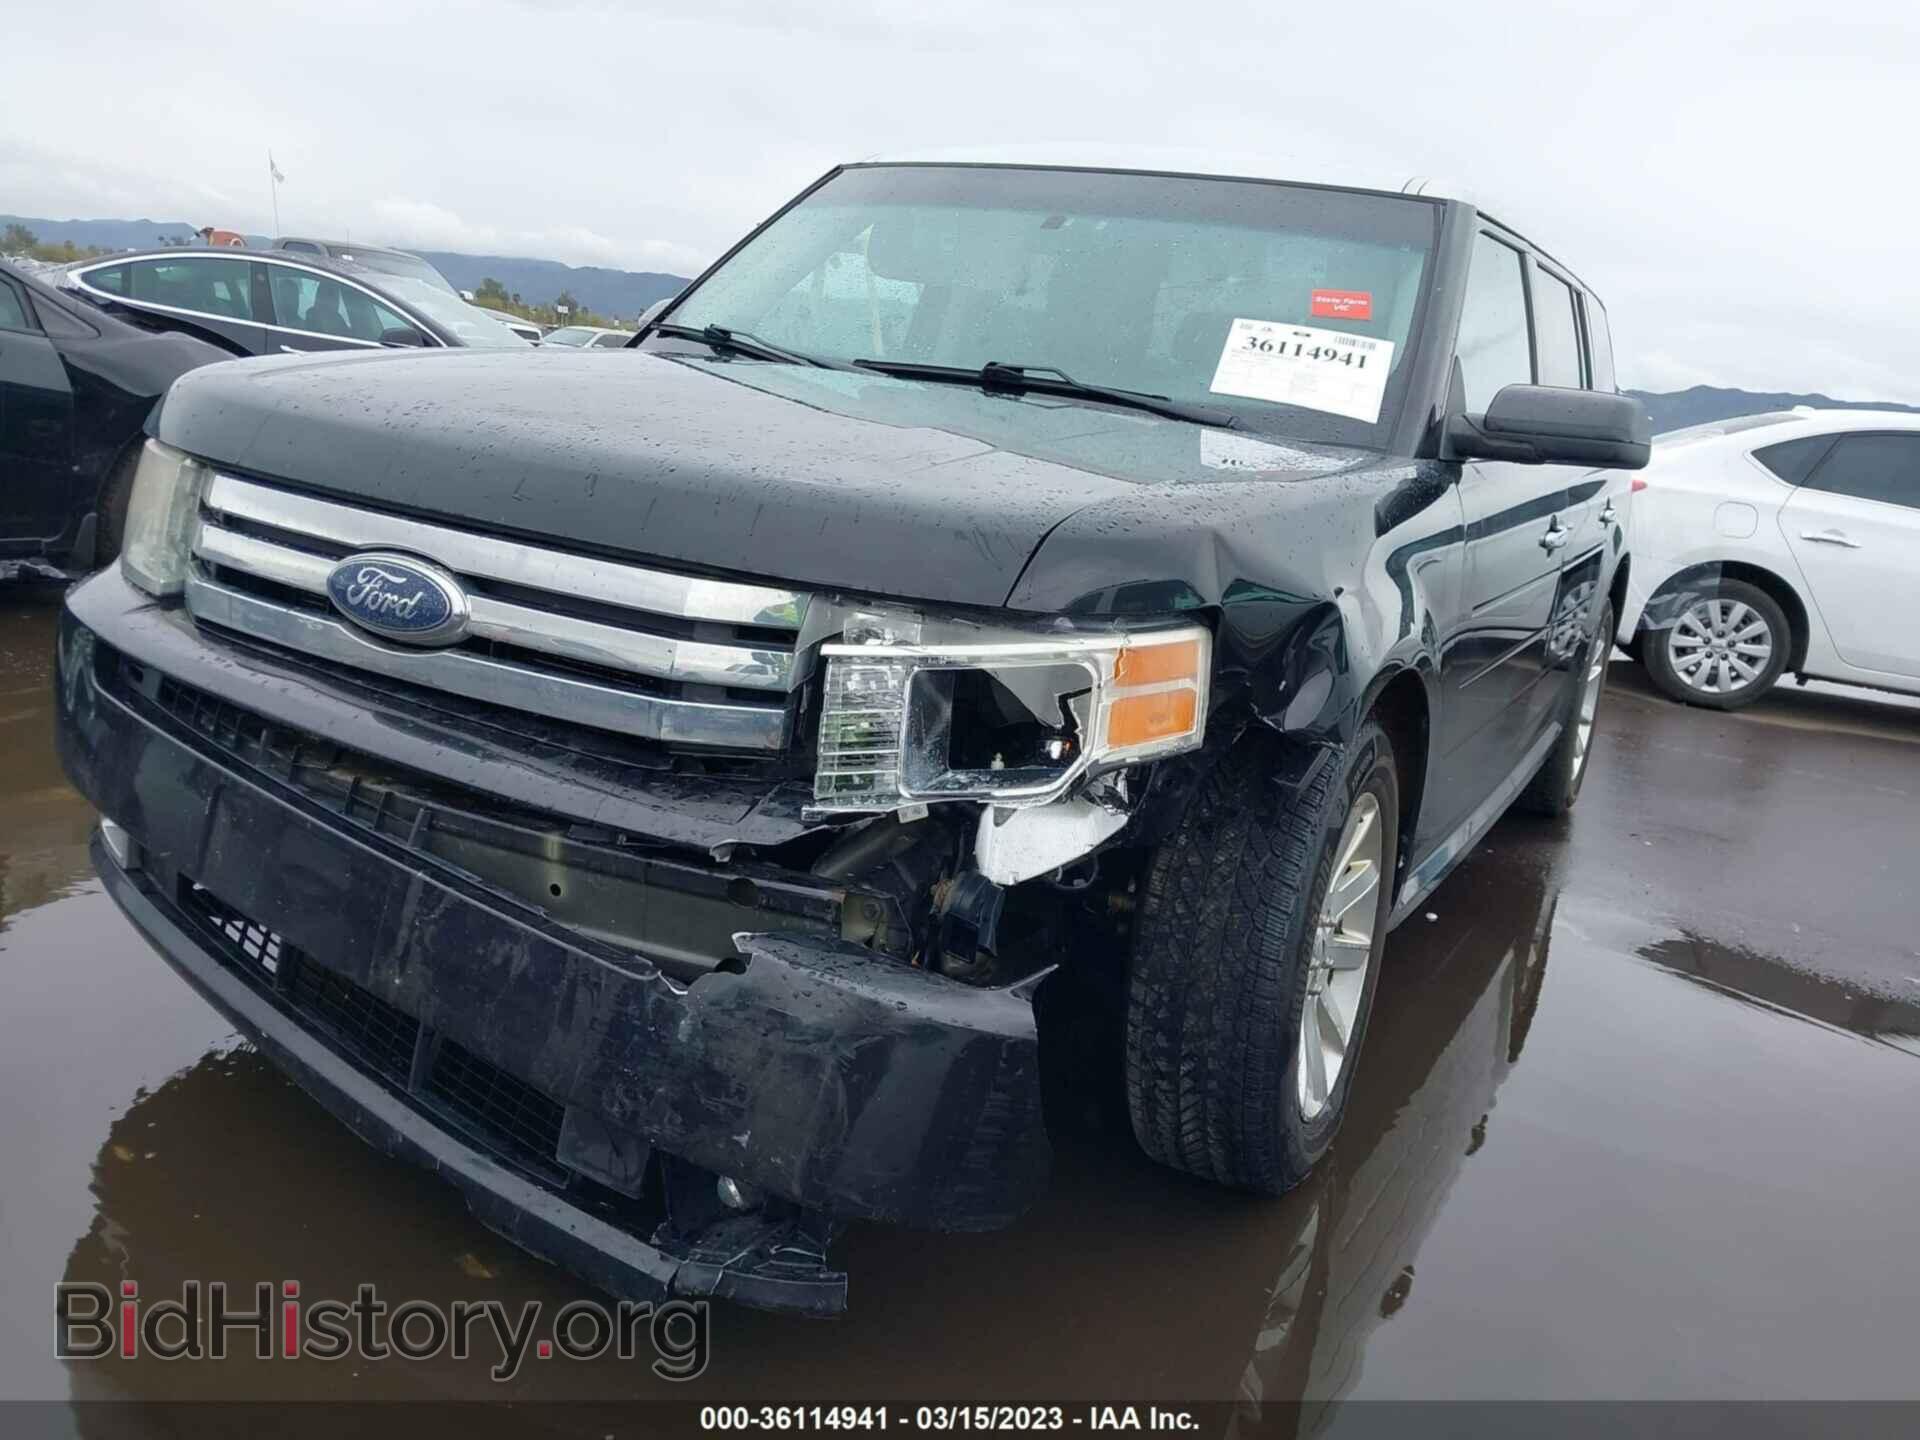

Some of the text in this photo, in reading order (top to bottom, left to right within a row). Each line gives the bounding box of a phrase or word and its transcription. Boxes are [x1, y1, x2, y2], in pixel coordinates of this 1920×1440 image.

[1315, 295, 1368, 306] State Farm
[1242, 336, 1368, 369] 36114941
[347, 566, 424, 620] Ford
